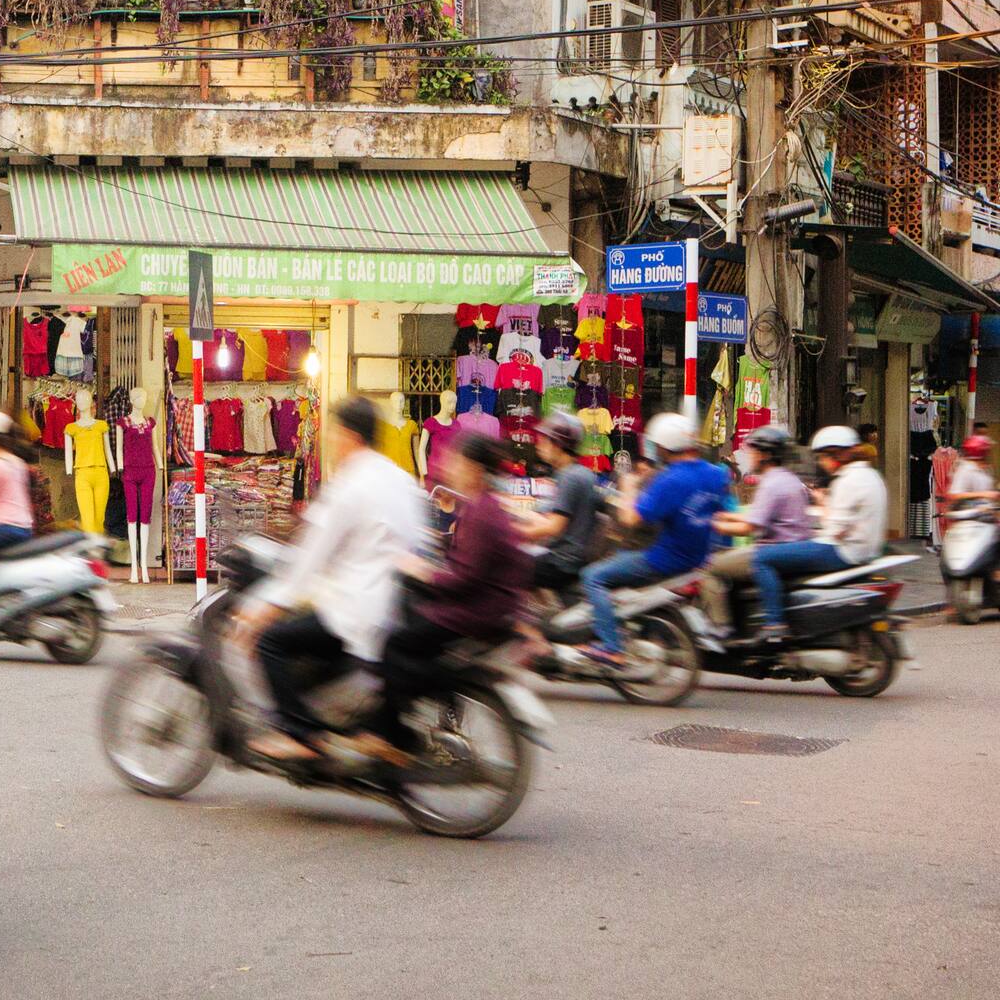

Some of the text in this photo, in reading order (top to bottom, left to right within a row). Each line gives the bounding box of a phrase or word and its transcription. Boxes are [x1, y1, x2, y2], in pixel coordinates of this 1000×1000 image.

[94, 247, 127, 279] LAN
[641, 249, 665, 263] PHỐ
[140, 250, 189, 276] CHUYÊ
[213, 252, 243, 278] UÔN
[347, 256, 376, 283] CÁC
[380, 260, 412, 288] LOẠI
[463, 263, 491, 286] CAO
[611, 265, 642, 285] HÀNG
[644, 263, 683, 283] ĐƯỜNG
[716, 302, 733, 315] PHỐ
[698, 313, 720, 333] HÀNG
